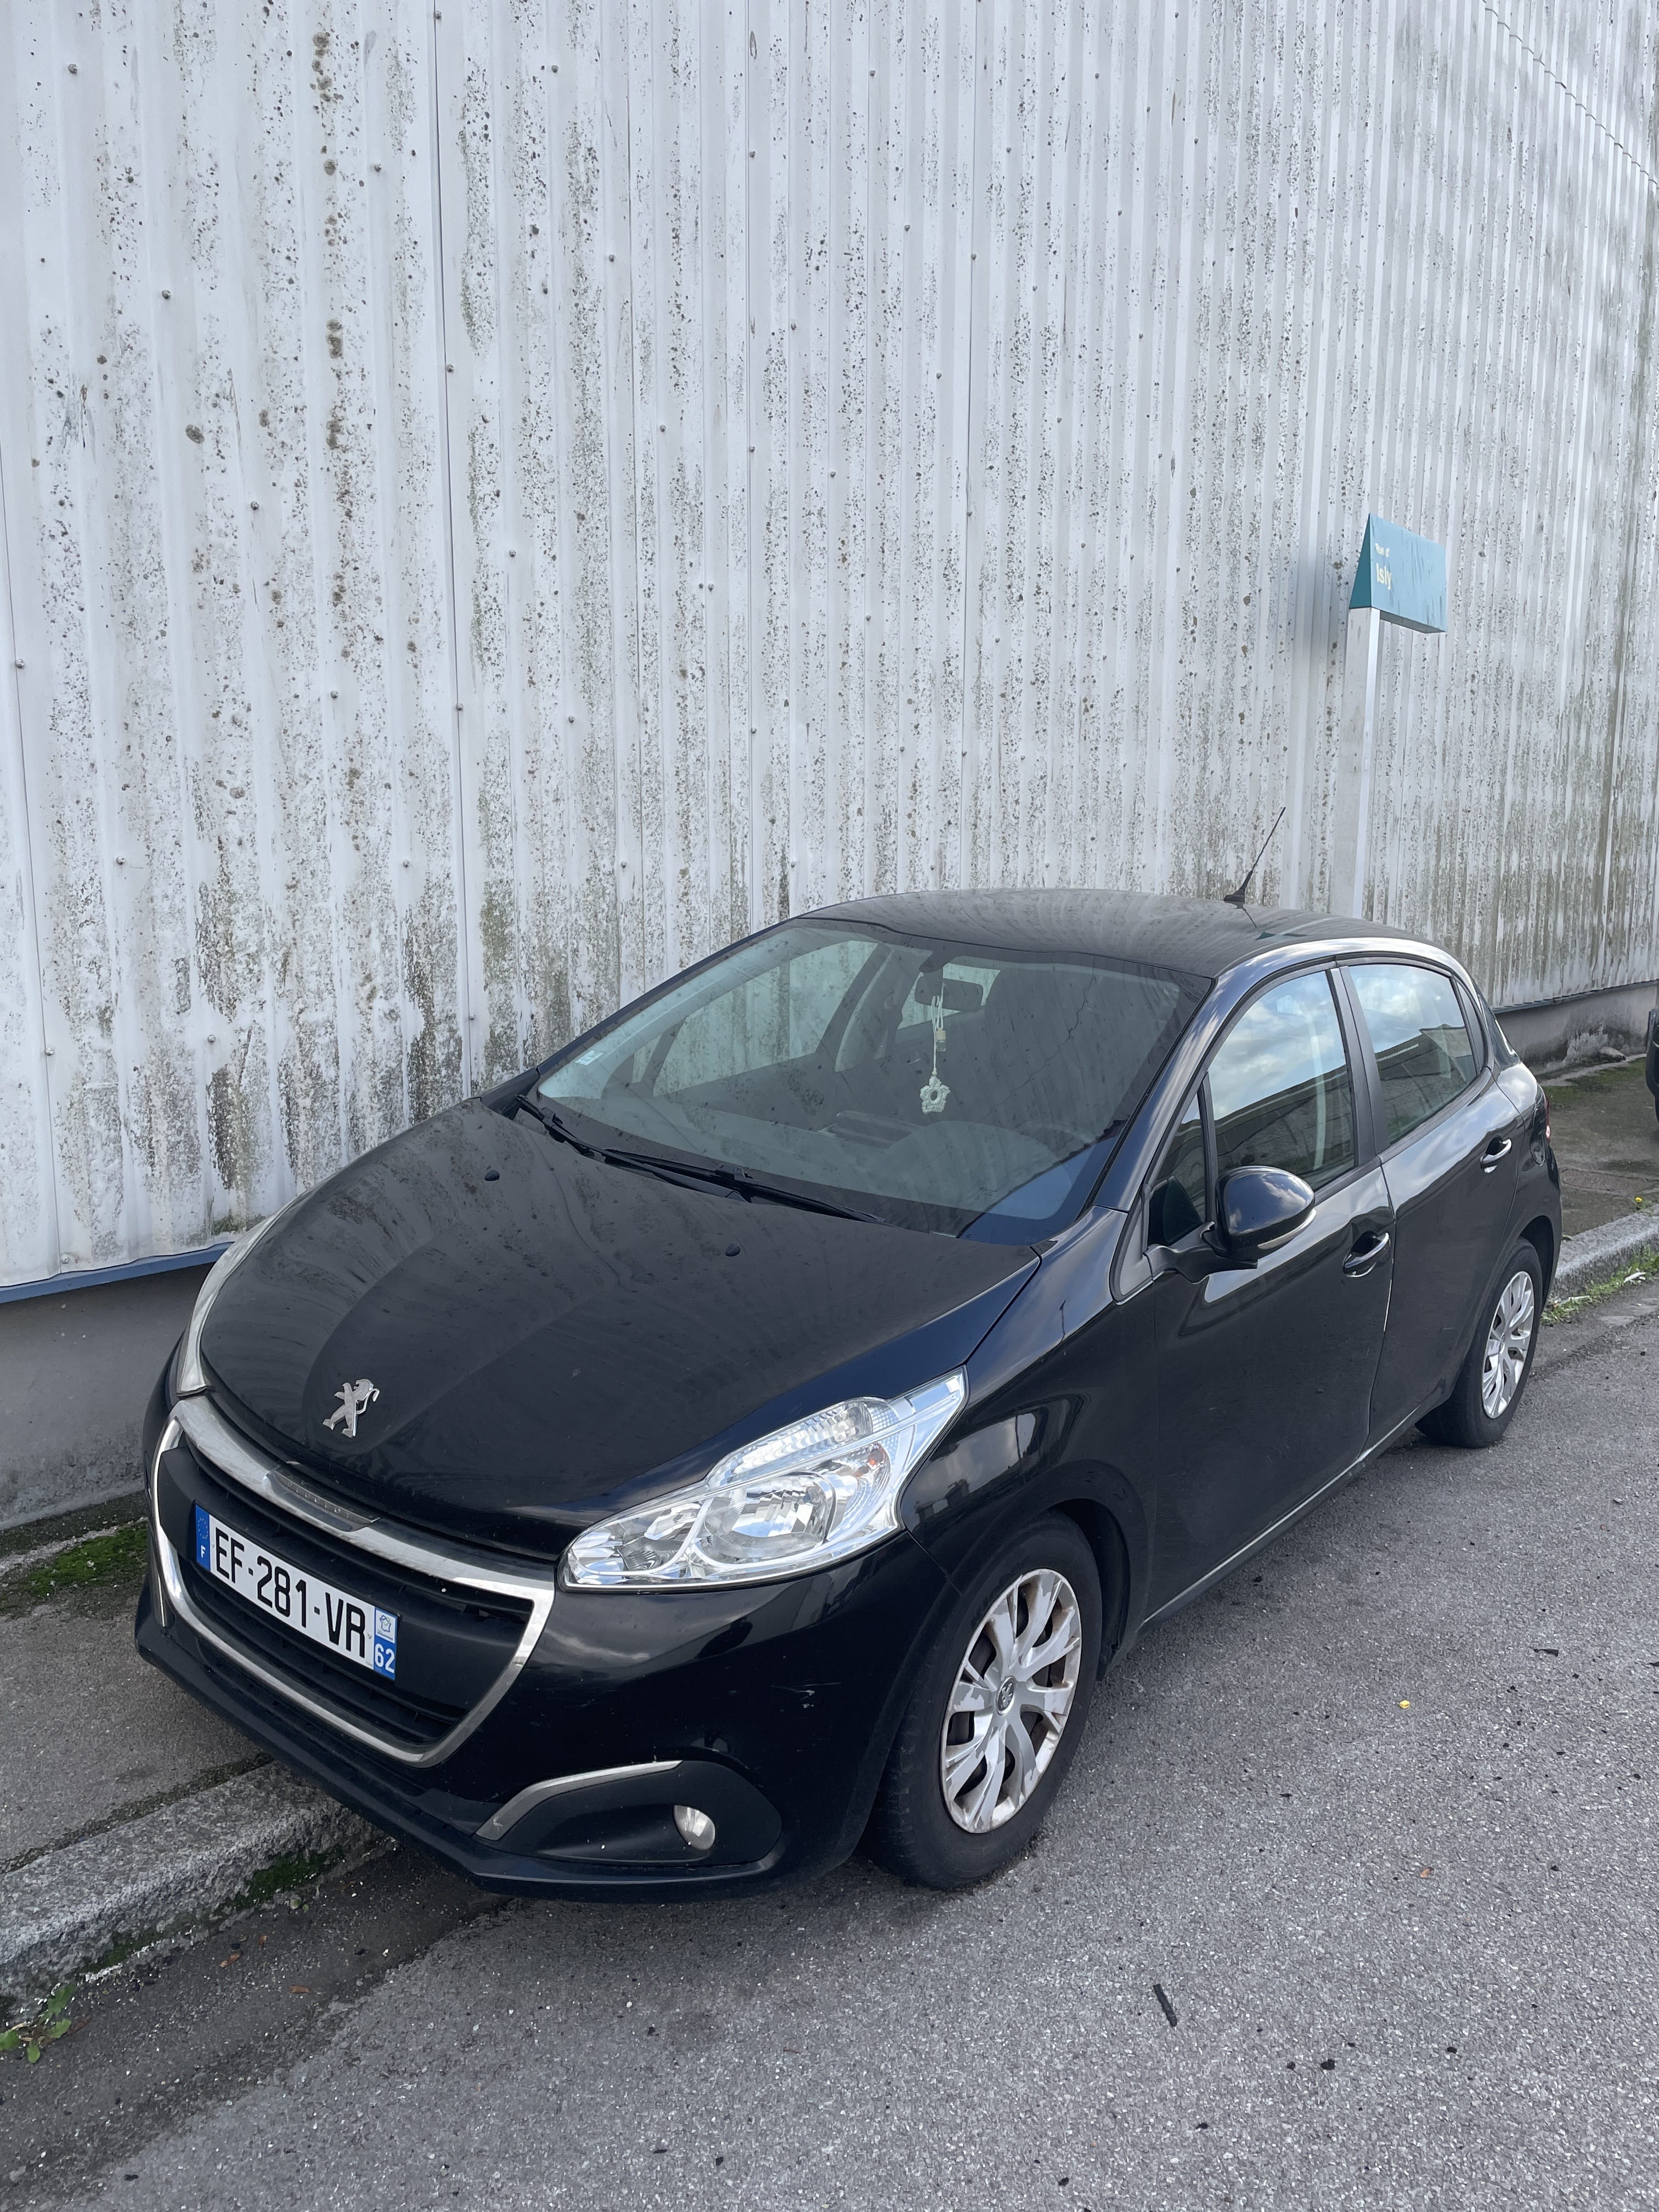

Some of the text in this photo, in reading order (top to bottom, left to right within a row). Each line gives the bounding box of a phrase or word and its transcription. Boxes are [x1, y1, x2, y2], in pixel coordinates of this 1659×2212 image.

[1376, 562, 1392, 590] Isly
[200, 1544, 206, 1558] F
[216, 1527, 365, 1658] EF-281-VR
[375, 1643, 395, 1674] 62
